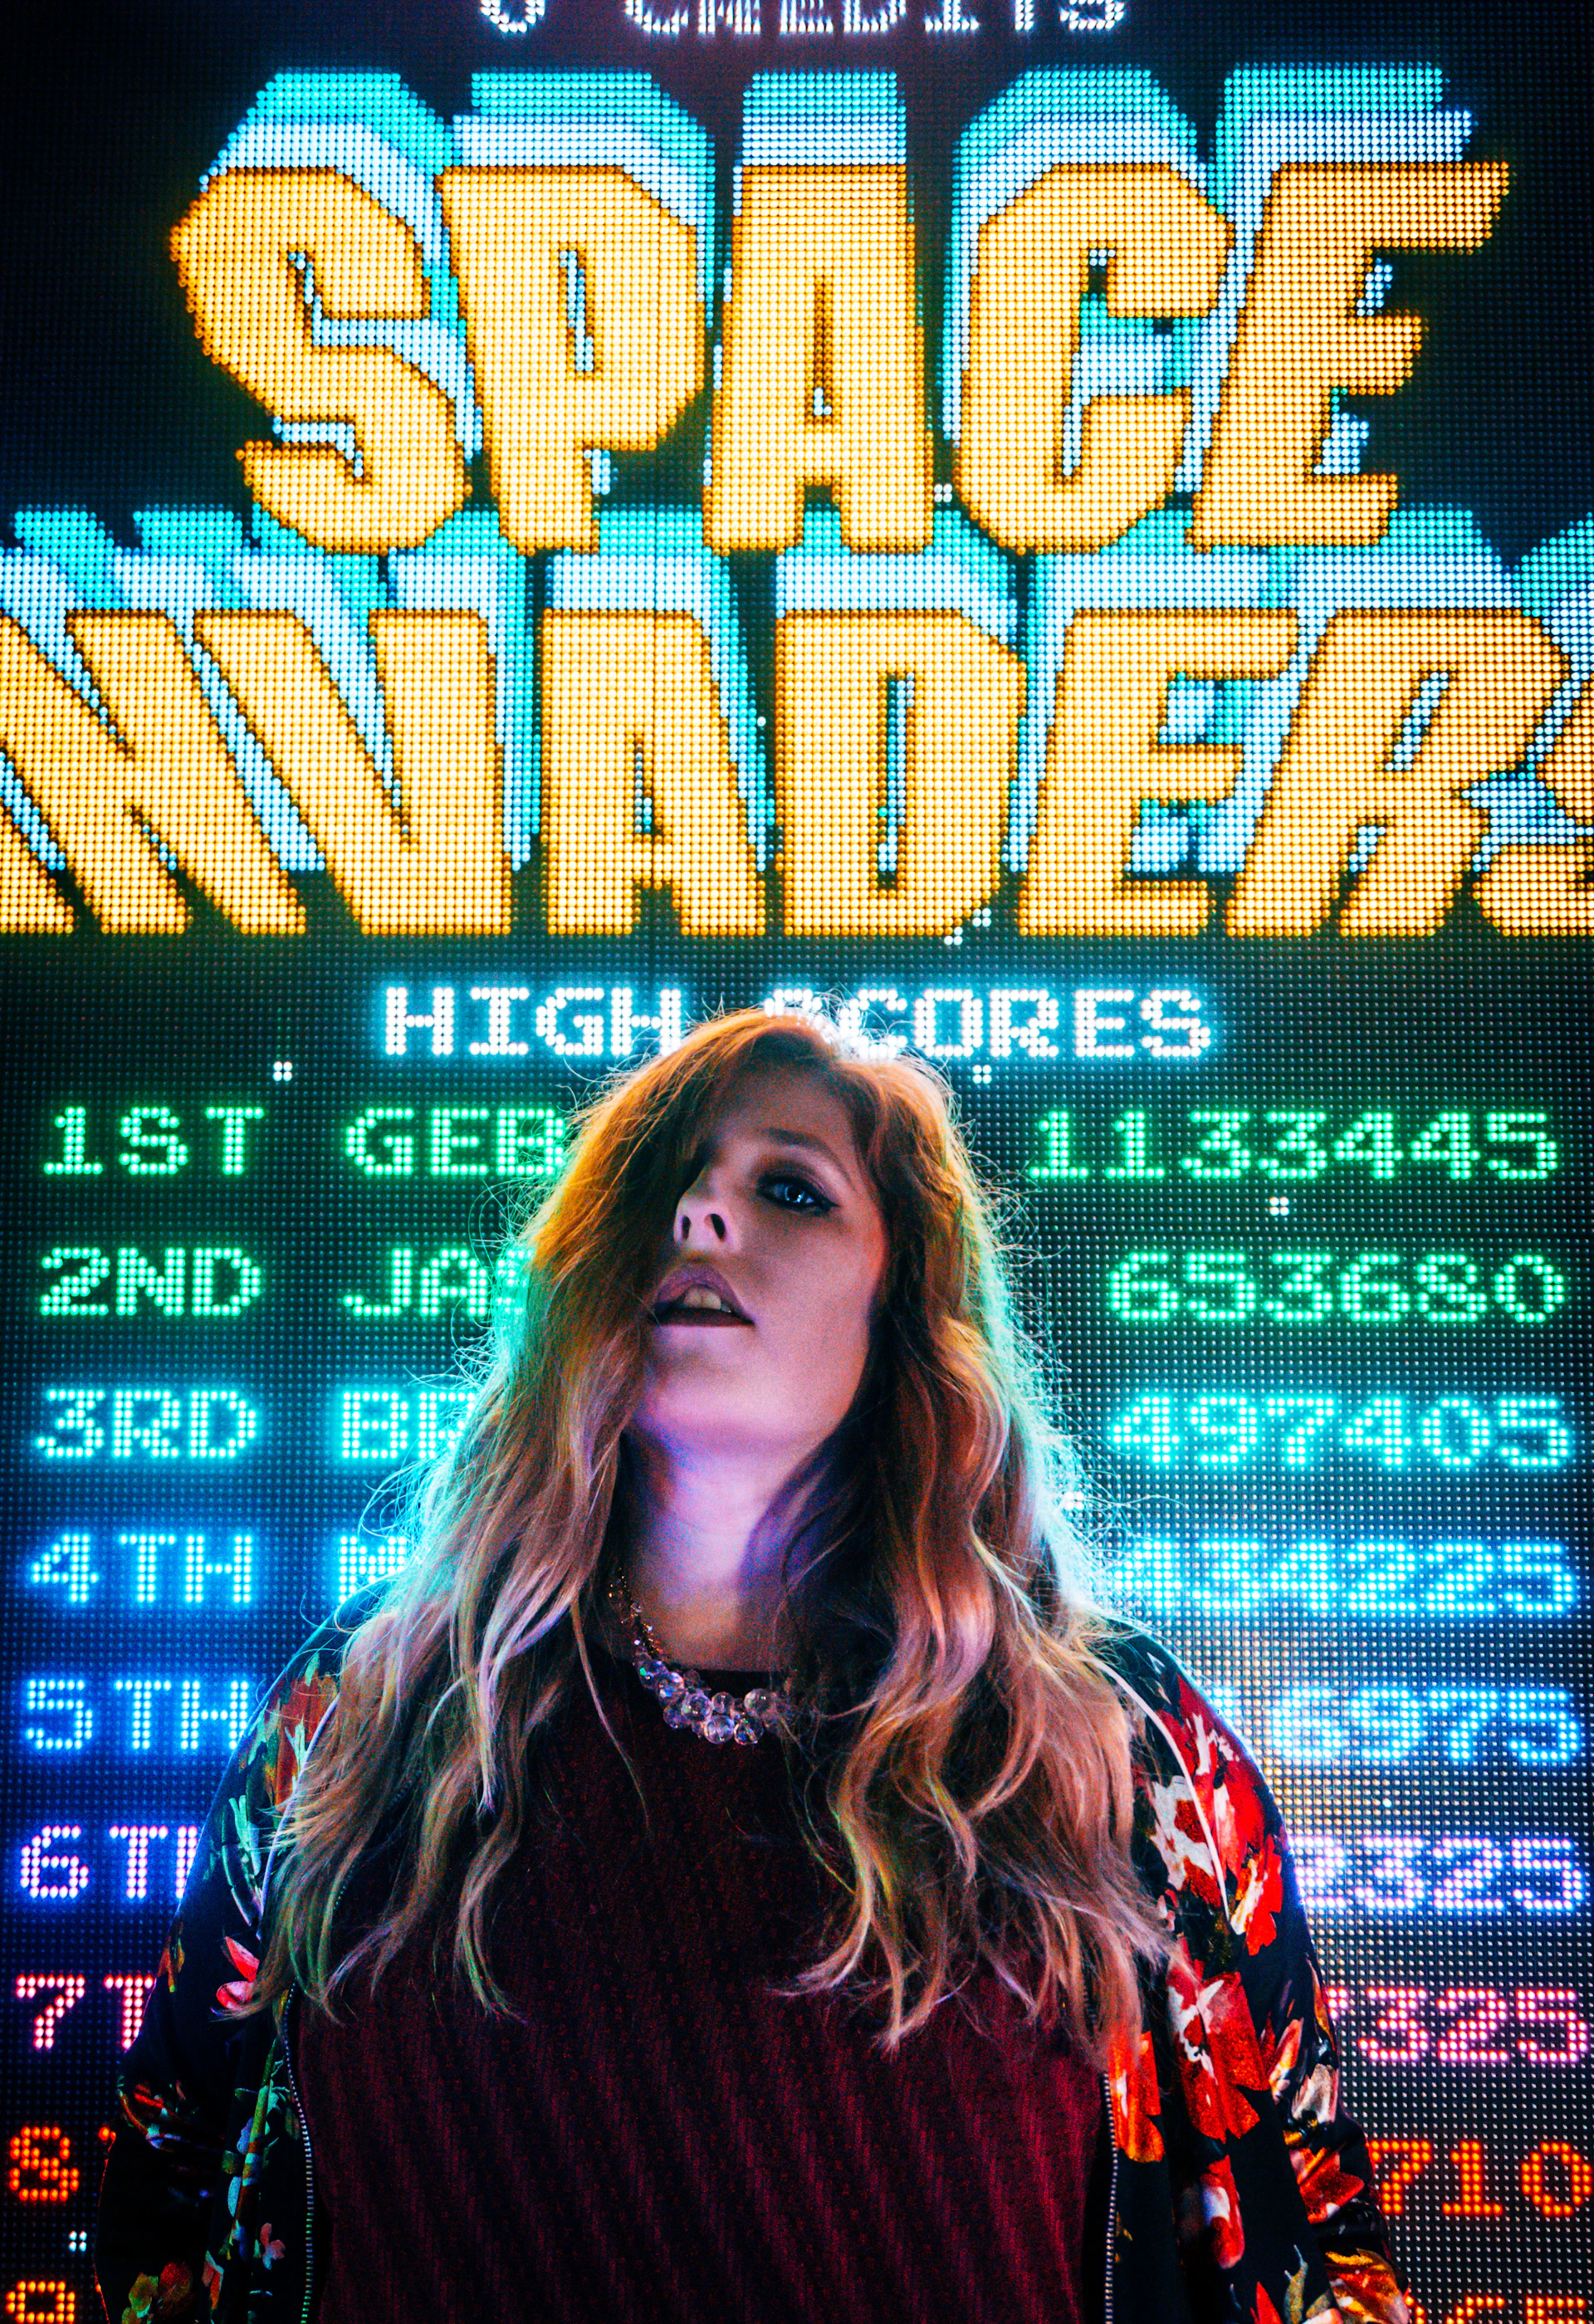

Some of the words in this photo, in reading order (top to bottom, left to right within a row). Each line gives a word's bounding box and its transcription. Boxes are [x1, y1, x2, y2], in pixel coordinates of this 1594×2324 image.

[170, 162, 1511, 554] SPACE
[384, 986, 682, 1057] HIGH
[42, 1106, 265, 1176] 1ST
[345, 1107, 567, 1176] GEB
[1028, 1109, 1561, 1181] 1133445
[39, 1246, 262, 1316] 2ND
[1108, 1252, 1567, 1323] 653680
[35, 1387, 258, 1458] 3RD
[341, 1390, 477, 1460] BR
[1109, 1395, 1571, 1468] 497405
[29, 1534, 253, 1604] 4TH
[1112, 1540, 1574, 1613] 434225
[26, 1678, 250, 1749] 5TH
[15, 1975, 157, 2049] 7T
[1327, 1988, 1589, 2064] 325
[1368, 2140, 1592, 2215] 710
